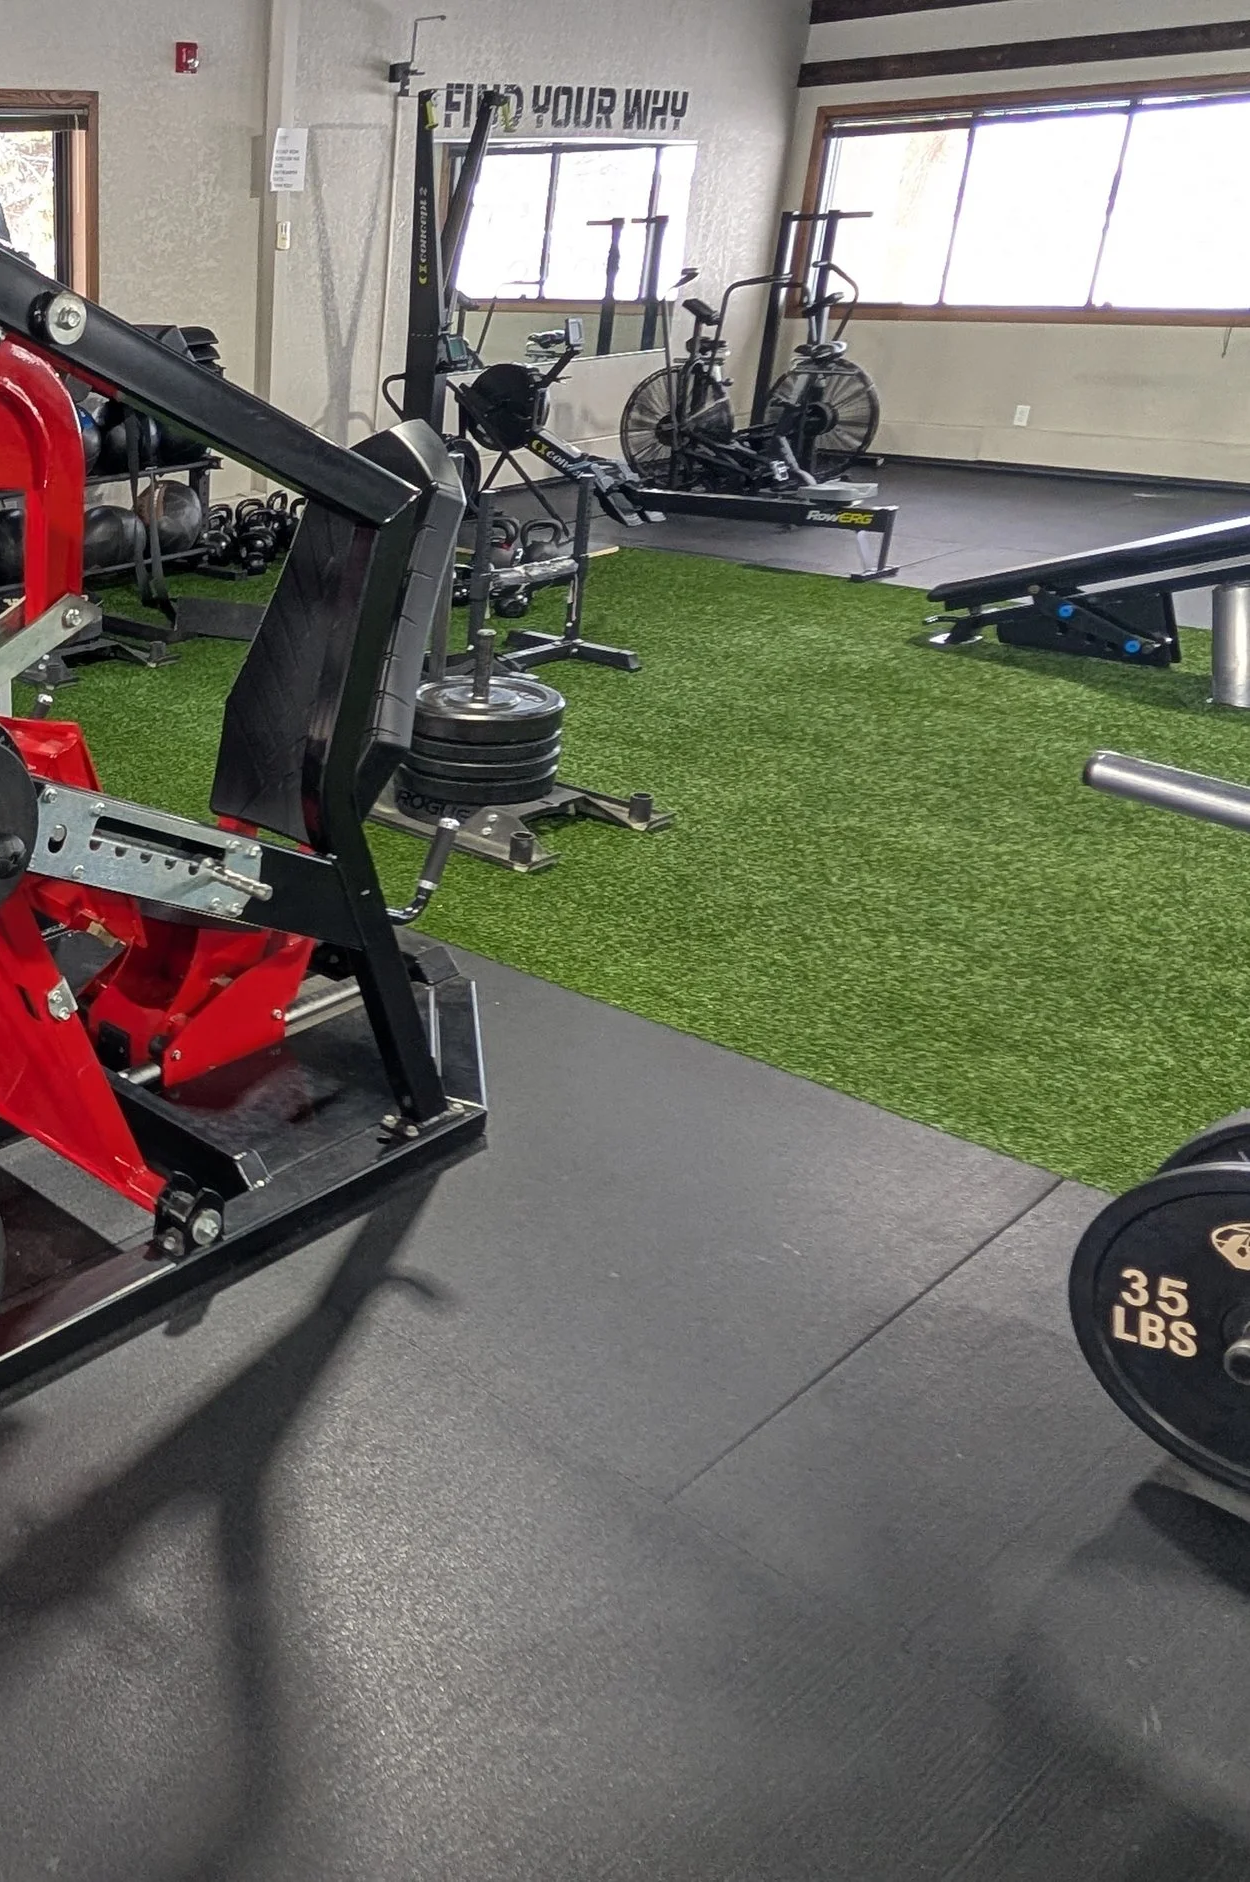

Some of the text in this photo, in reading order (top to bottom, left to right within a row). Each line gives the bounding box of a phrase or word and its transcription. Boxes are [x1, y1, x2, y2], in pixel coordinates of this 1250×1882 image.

[532, 85, 616, 128] YOUR
[623, 88, 689, 131] WHY
[1120, 1268, 1188, 1317] 35
[1113, 1305, 1198, 1358] LBS
